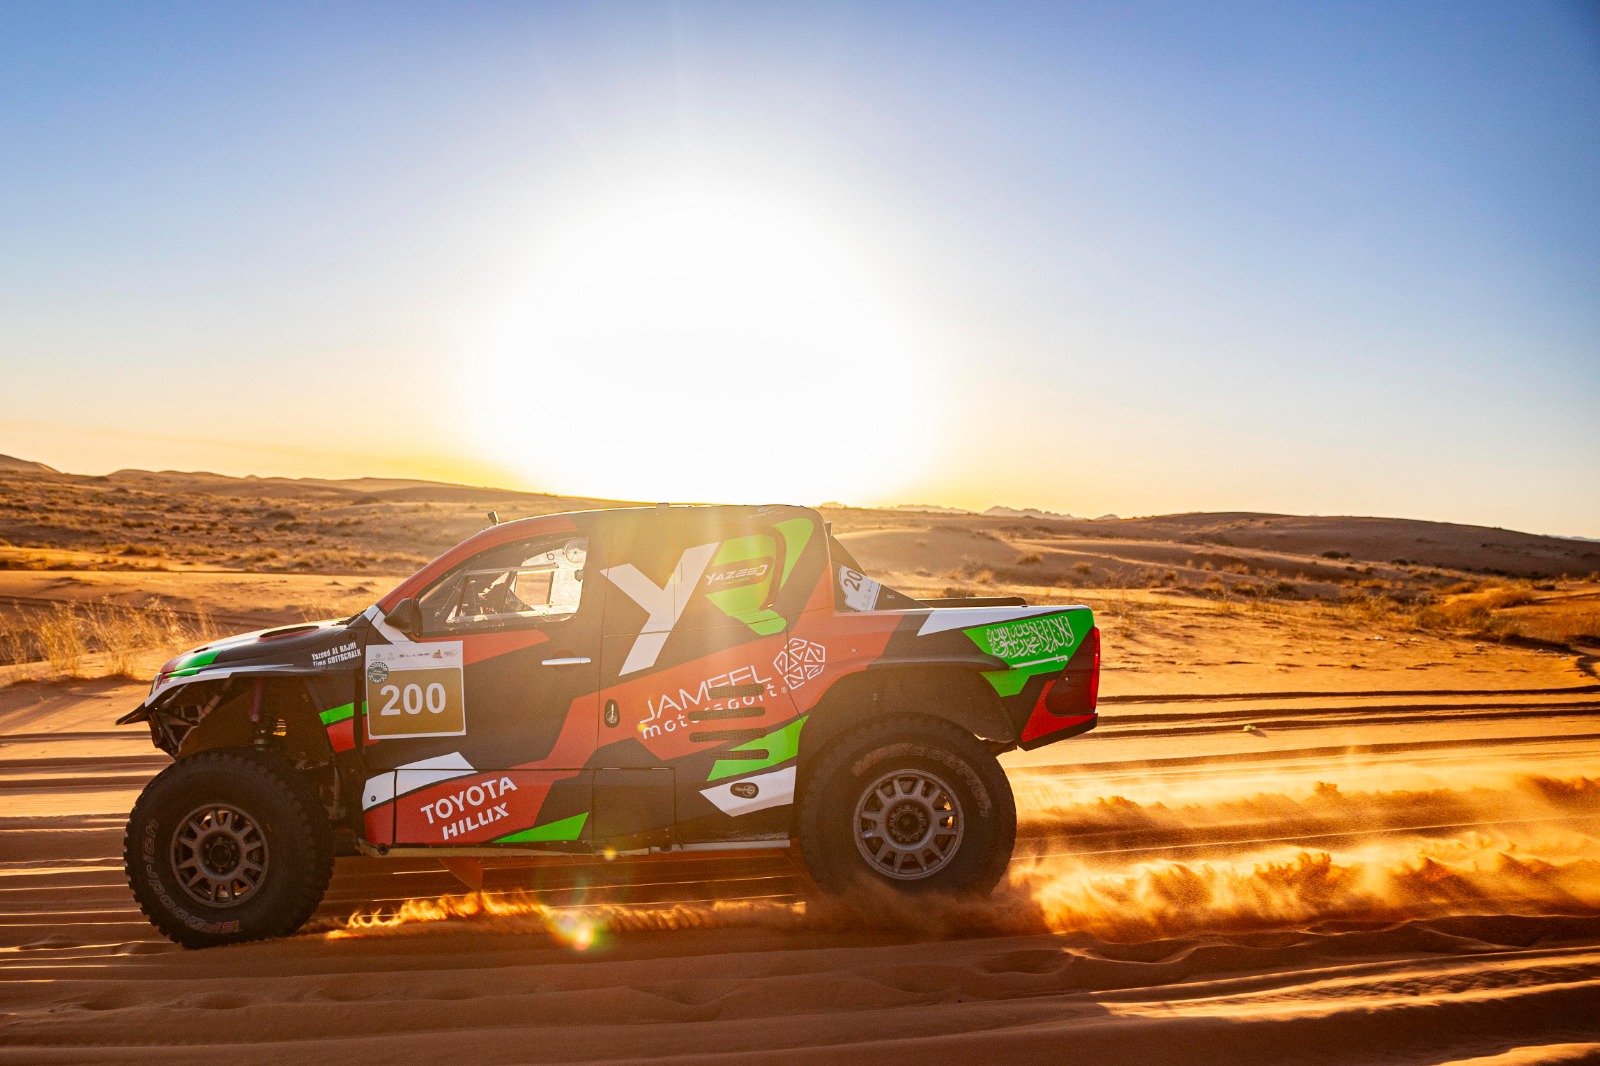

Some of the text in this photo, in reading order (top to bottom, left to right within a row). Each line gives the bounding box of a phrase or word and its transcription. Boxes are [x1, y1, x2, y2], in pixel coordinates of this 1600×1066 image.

[311, 641, 357, 661] Yazeed AL RAJHI
[380, 682, 447, 716] 200
[420, 776, 518, 825] TOYOTA
[442, 802, 510, 841] HILUX
